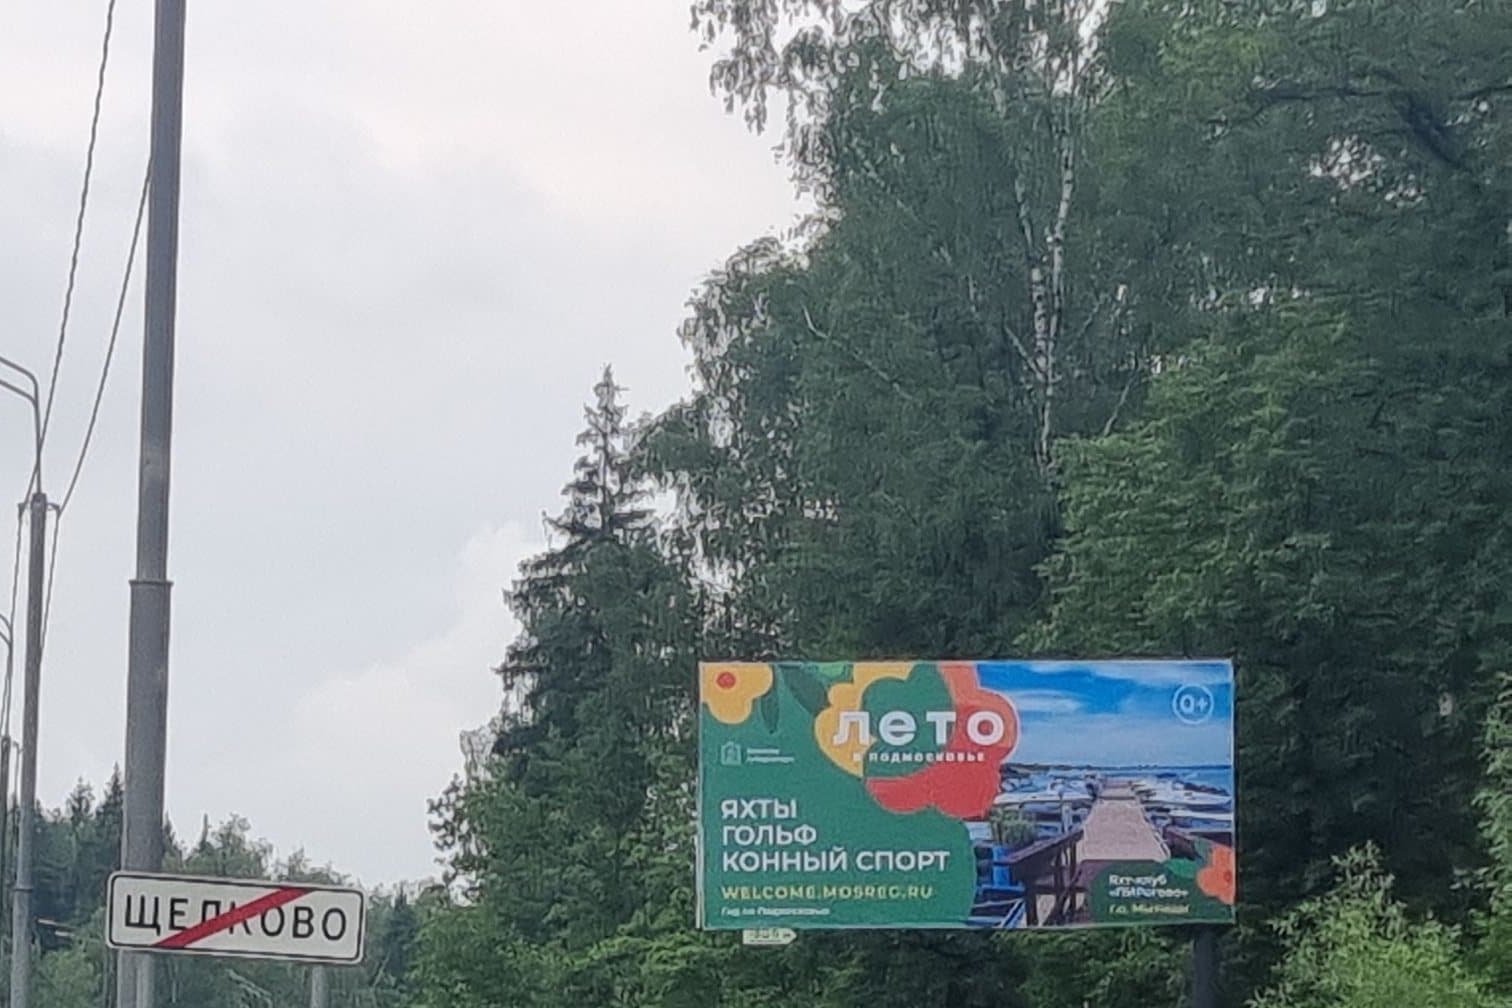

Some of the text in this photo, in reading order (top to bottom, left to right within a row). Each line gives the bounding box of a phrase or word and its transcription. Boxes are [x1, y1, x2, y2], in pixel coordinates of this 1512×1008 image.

[721, 798, 797, 819] ЯХТЫ
[723, 824, 817, 846] ГОЛЬФ
[723, 846, 951, 872] КОННЫЙ СПОРТ
[124, 894, 347, 941] ЩЕЛКОВО
